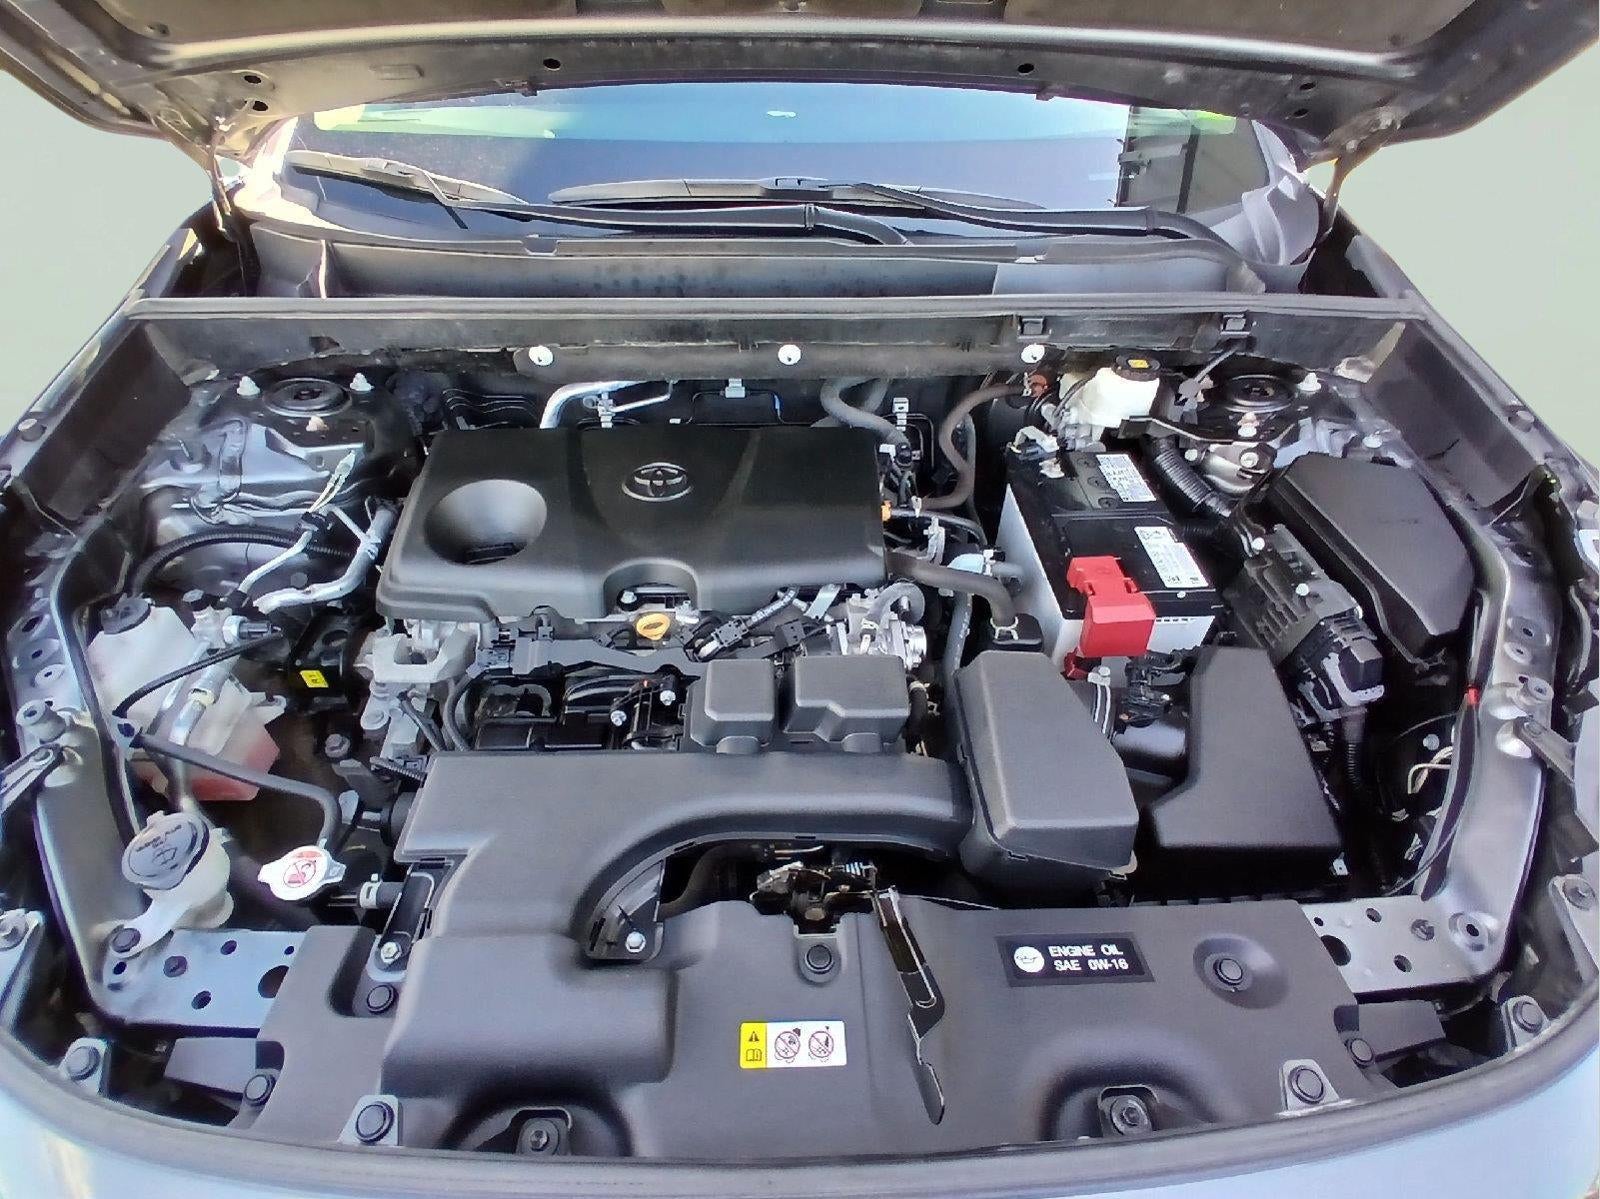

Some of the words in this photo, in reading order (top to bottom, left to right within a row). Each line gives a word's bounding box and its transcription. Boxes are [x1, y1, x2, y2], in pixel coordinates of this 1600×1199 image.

[1048, 945, 1095, 957] ENGINE
[1101, 944, 1123, 956] OIL
[1054, 959, 1082, 971] SAE
[1087, 958, 1129, 971] 0W-16
